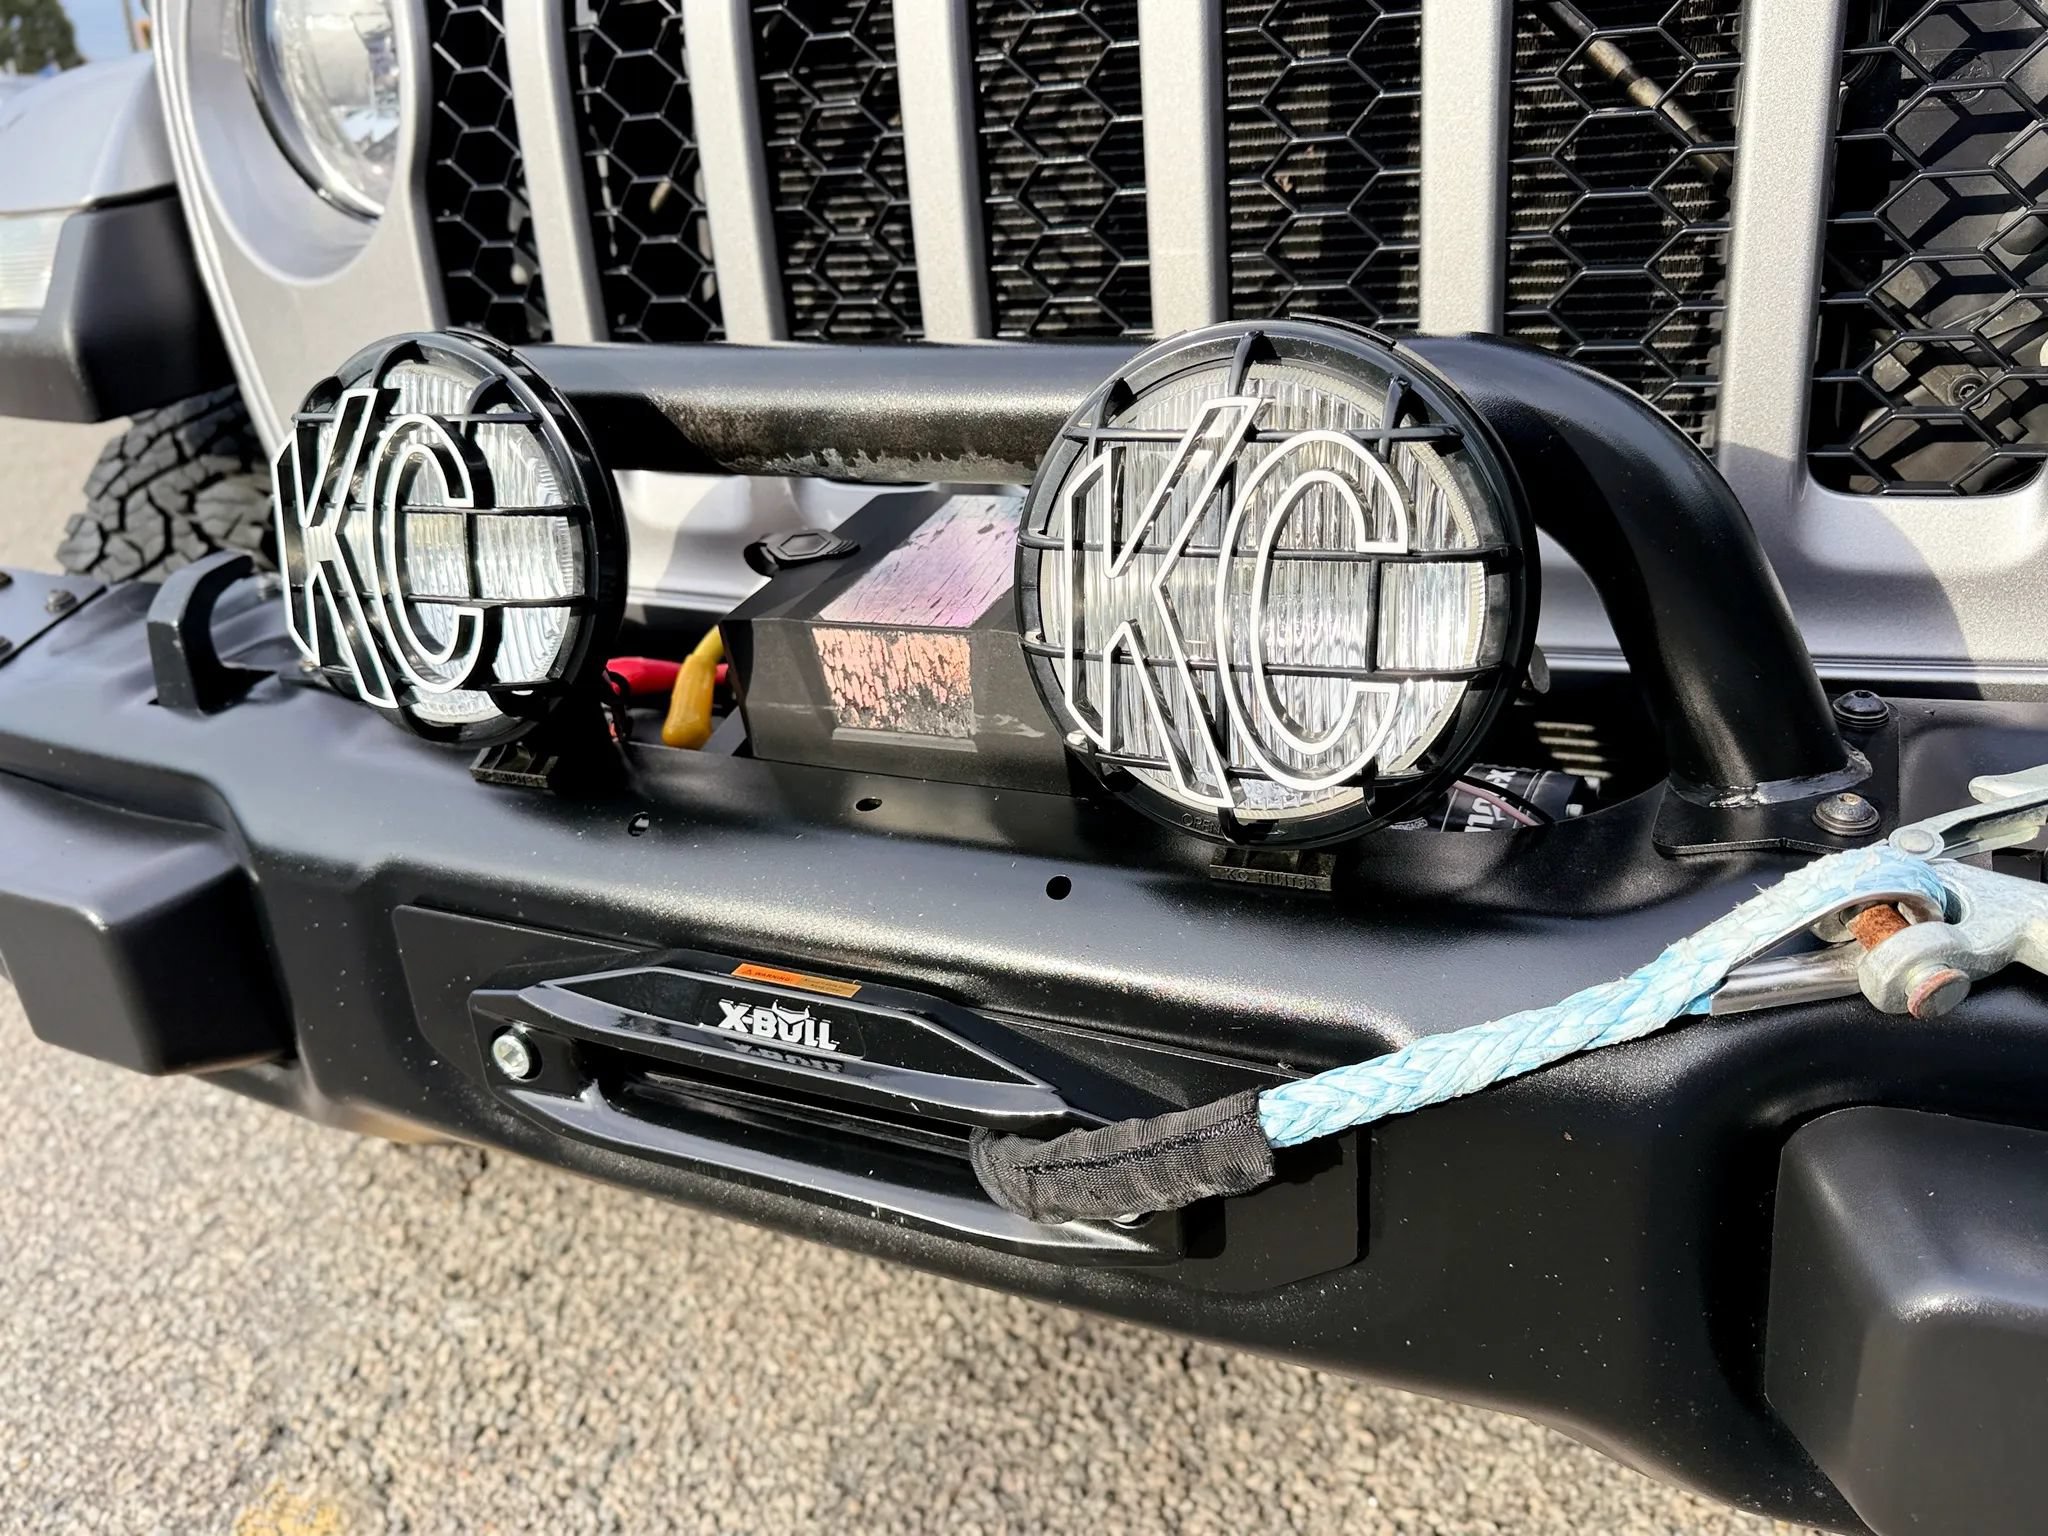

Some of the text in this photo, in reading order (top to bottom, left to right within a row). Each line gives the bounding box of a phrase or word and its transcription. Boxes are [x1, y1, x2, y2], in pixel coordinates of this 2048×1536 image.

[273, 388, 484, 708] KC
[1065, 397, 1408, 807] KC
[718, 999, 840, 1050] X-BULL
